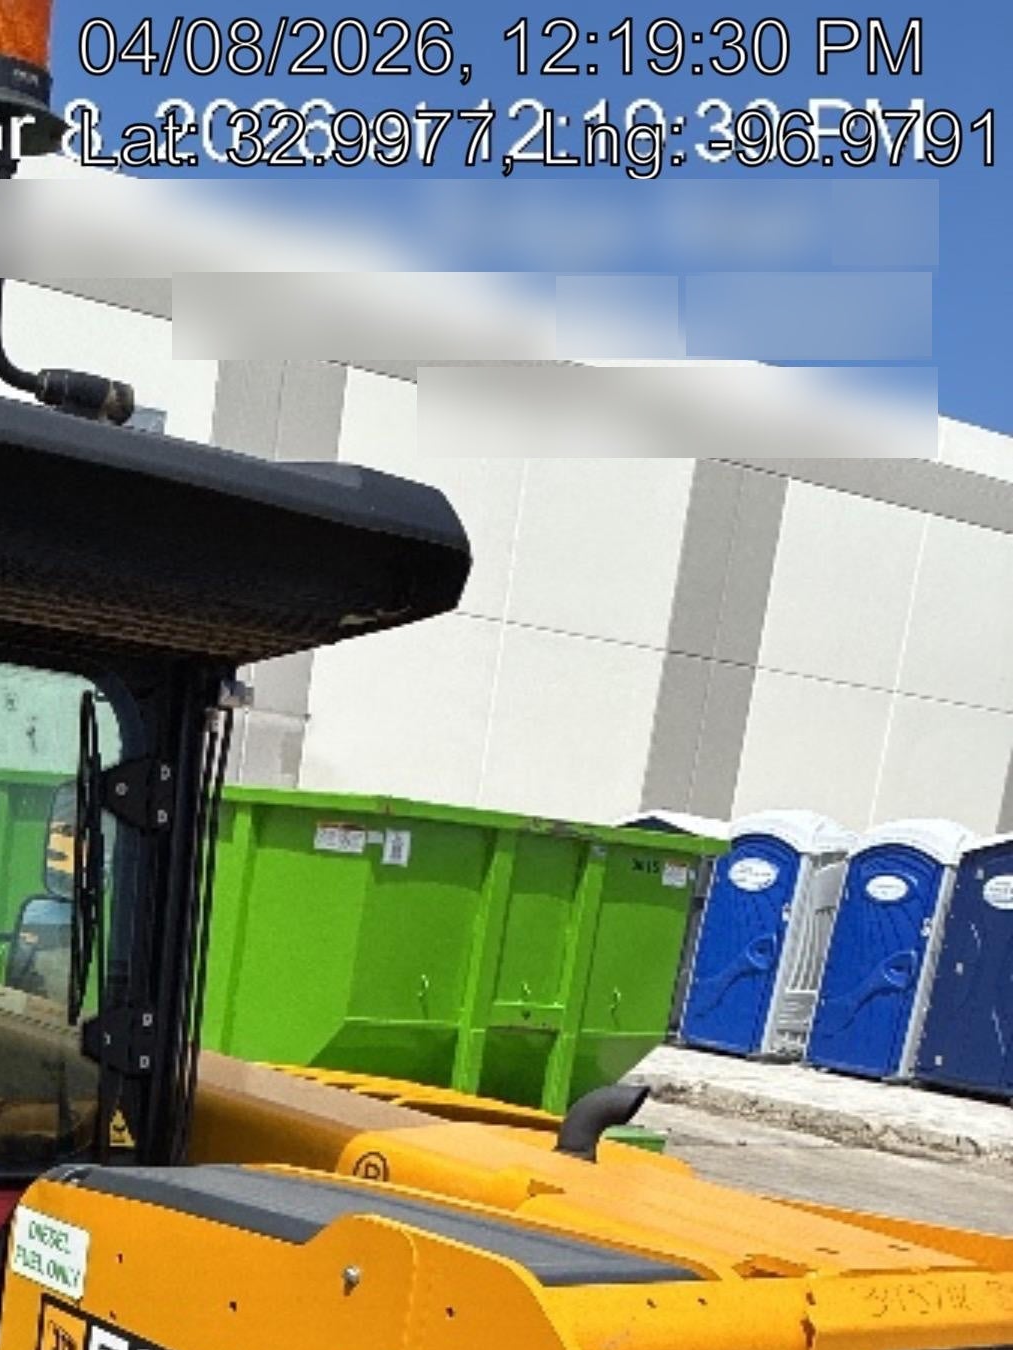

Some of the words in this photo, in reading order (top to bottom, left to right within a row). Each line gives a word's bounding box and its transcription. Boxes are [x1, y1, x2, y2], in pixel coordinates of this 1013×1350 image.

[28, 1220, 72, 1254] DIESEL
[13, 1244, 44, 1275] FUEL
[46, 1259, 81, 1289] ONLY
